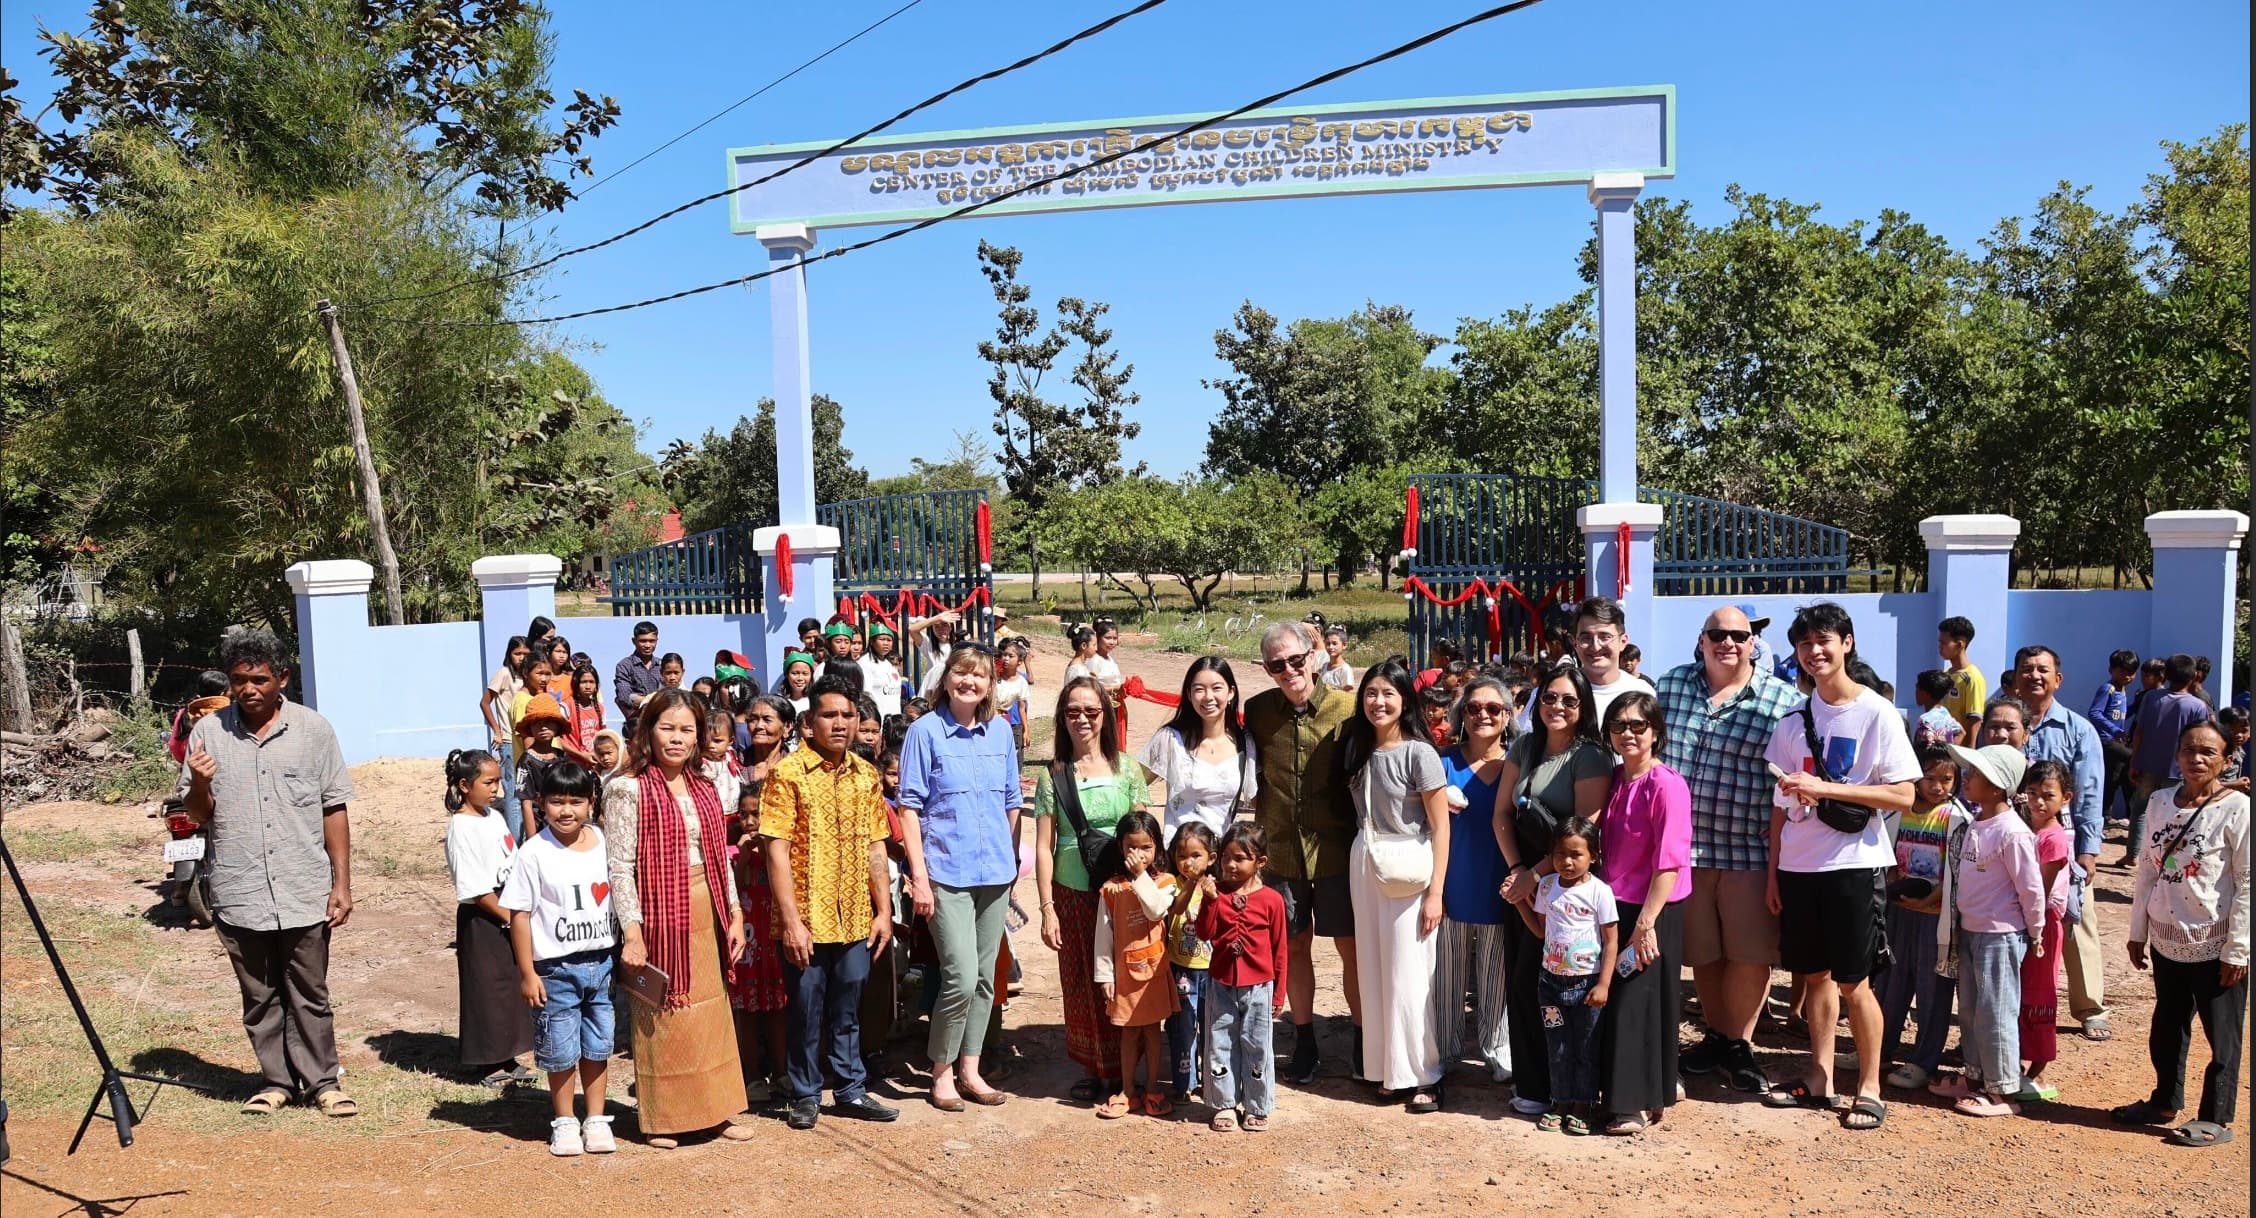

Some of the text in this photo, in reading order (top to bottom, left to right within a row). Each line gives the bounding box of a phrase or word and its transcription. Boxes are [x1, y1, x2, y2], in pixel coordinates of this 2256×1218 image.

[871, 137, 1504, 191] CENTER OF THE CAMBODIAN CHILDREN MINISTRY
[572, 884, 584, 911] I
